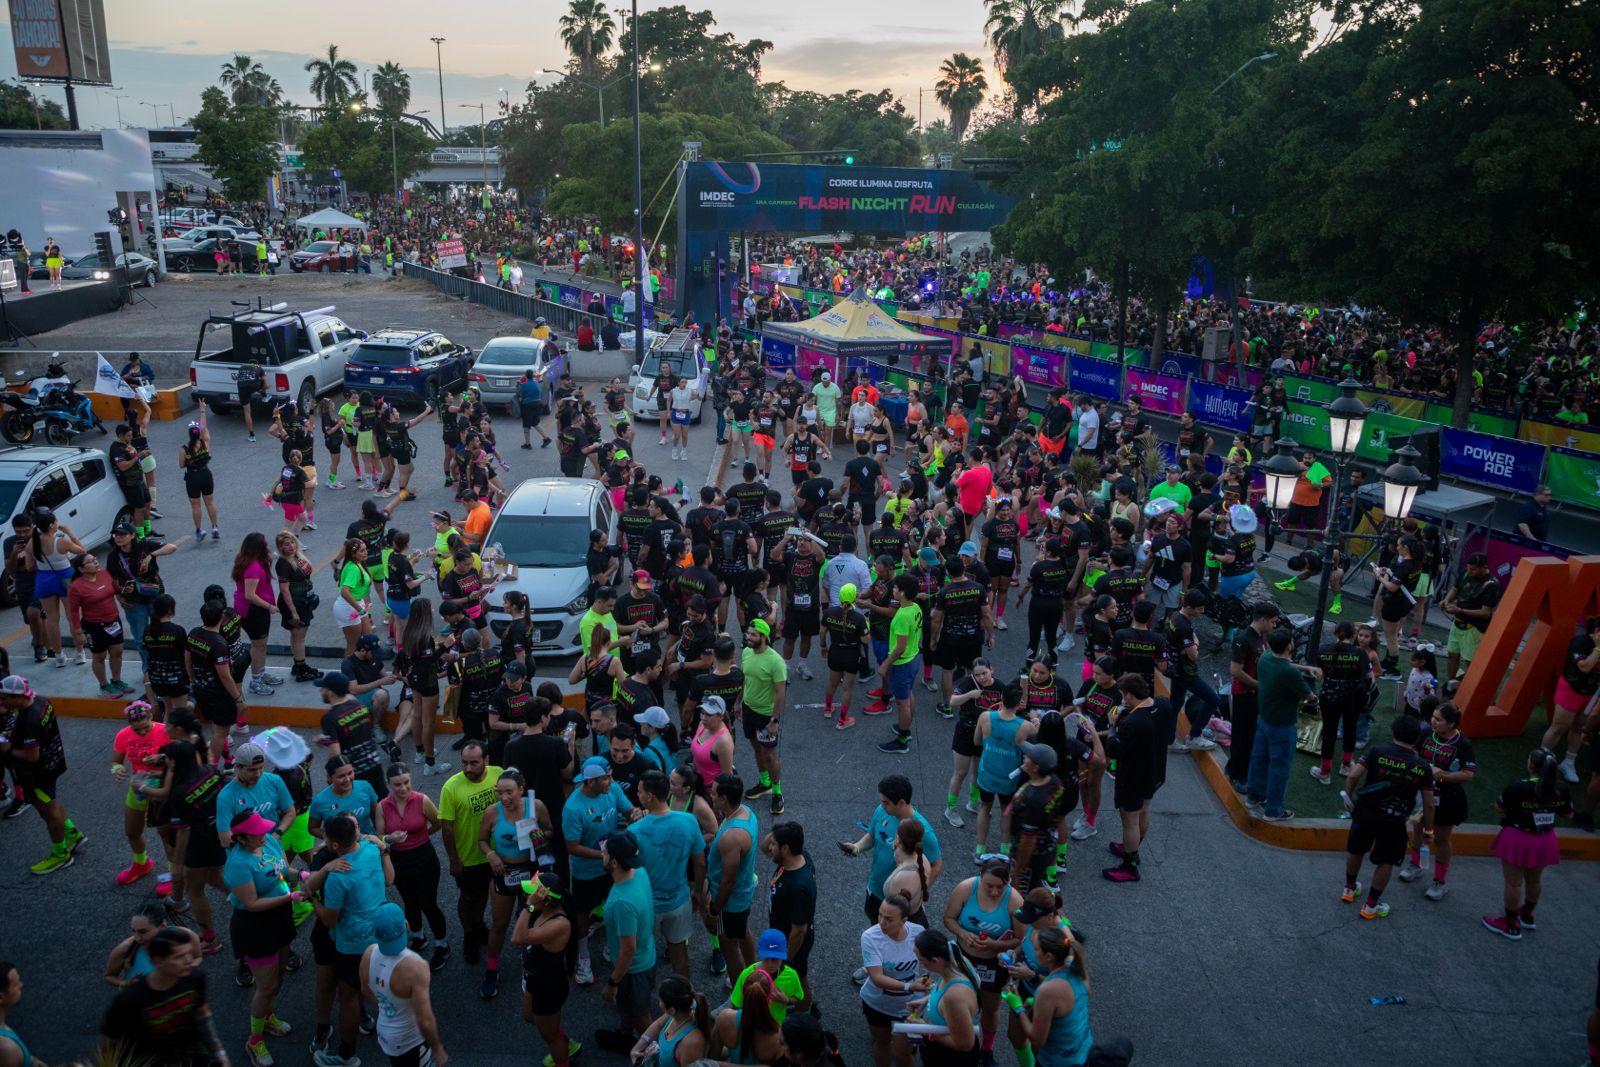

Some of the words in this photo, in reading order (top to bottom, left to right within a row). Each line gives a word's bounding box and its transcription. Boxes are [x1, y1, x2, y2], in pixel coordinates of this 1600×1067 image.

[829, 179, 858, 188] CORRE
[859, 180, 893, 188] ILUMINA
[894, 180, 933, 189] DISFRUTA
[700, 191, 735, 201] IMDEC
[798, 196, 850, 210] FLASH
[851, 198, 909, 211] NIGHT
[909, 195, 957, 214] RUN
[1141, 382, 1169, 395] IMDEC
[1283, 411, 1318, 426] IMDEC
[1463, 445, 1516, 466] POWER
[1483, 461, 1514, 478] ADE
